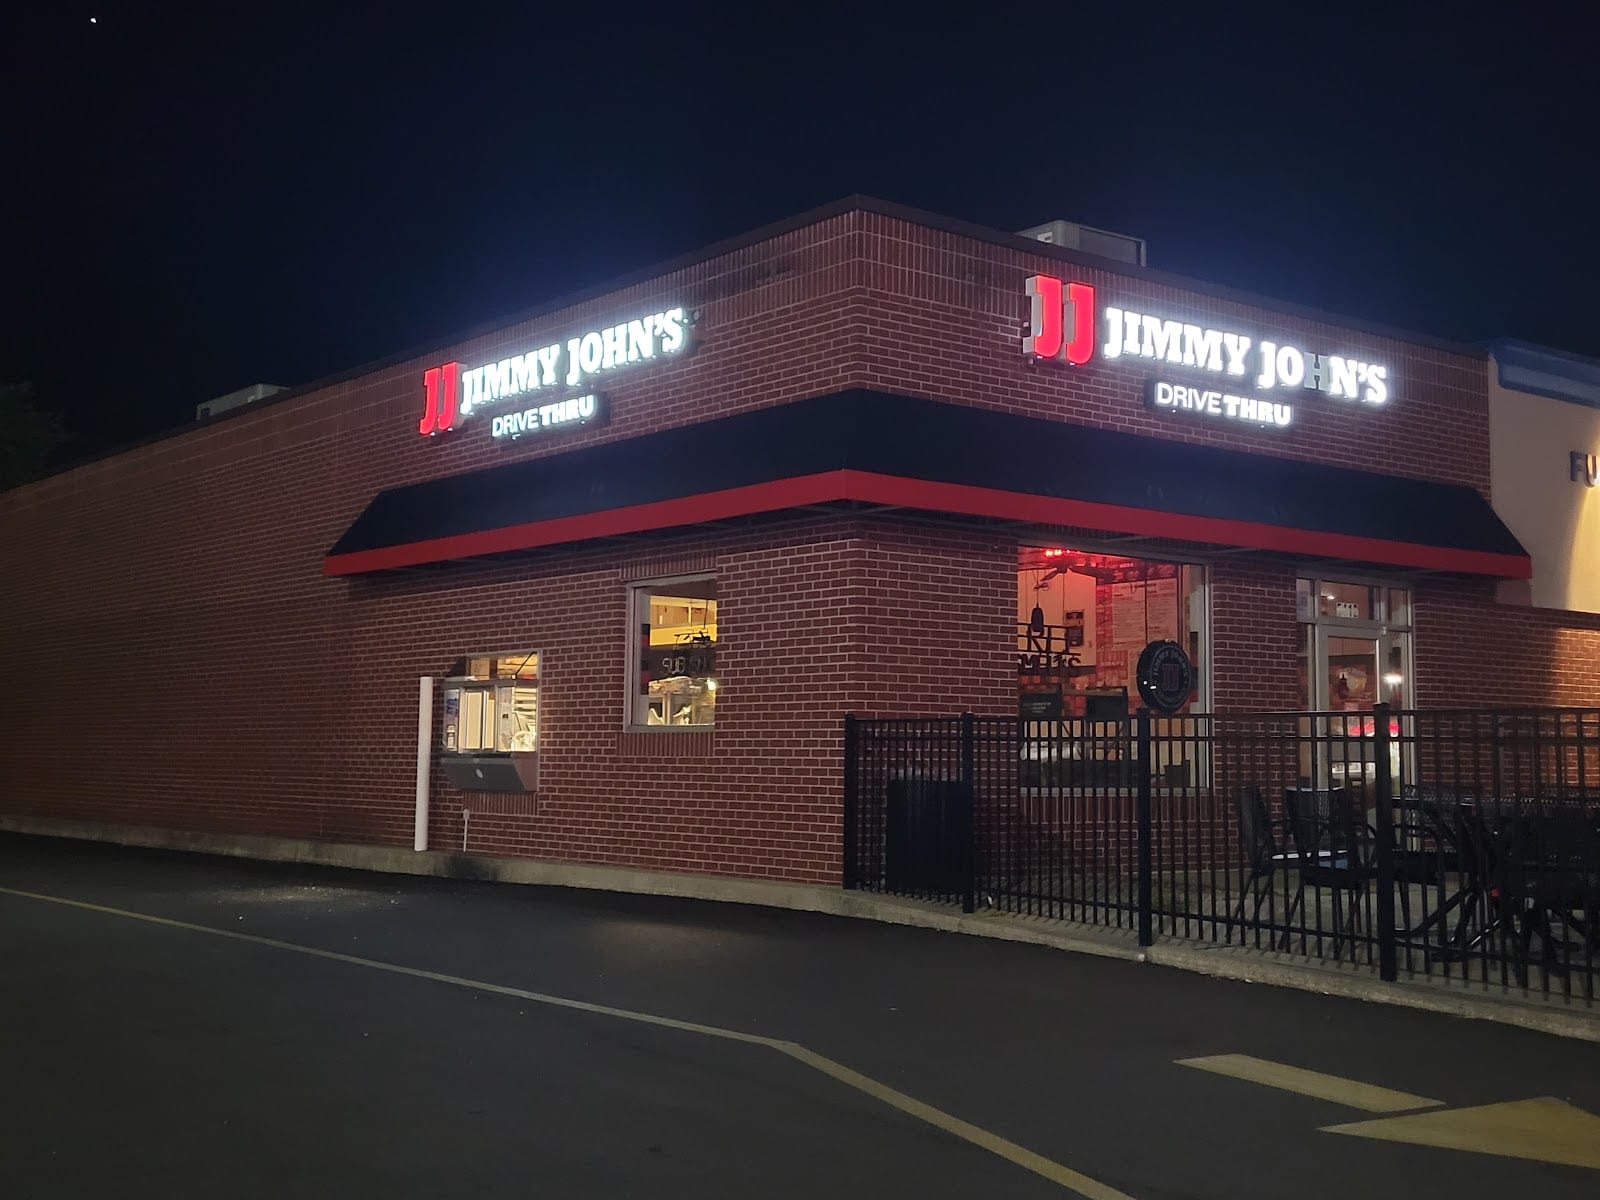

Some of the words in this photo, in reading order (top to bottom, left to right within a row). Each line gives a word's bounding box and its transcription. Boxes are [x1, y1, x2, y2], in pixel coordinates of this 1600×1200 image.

[460, 343, 560, 415] JIMMY
[566, 308, 683, 386] JOHN'S
[1029, 274, 1096, 366] JJ
[1104, 307, 1251, 376] JIMMY
[1257, 340, 1388, 404] JOHN'S
[419, 361, 460, 436] JJ
